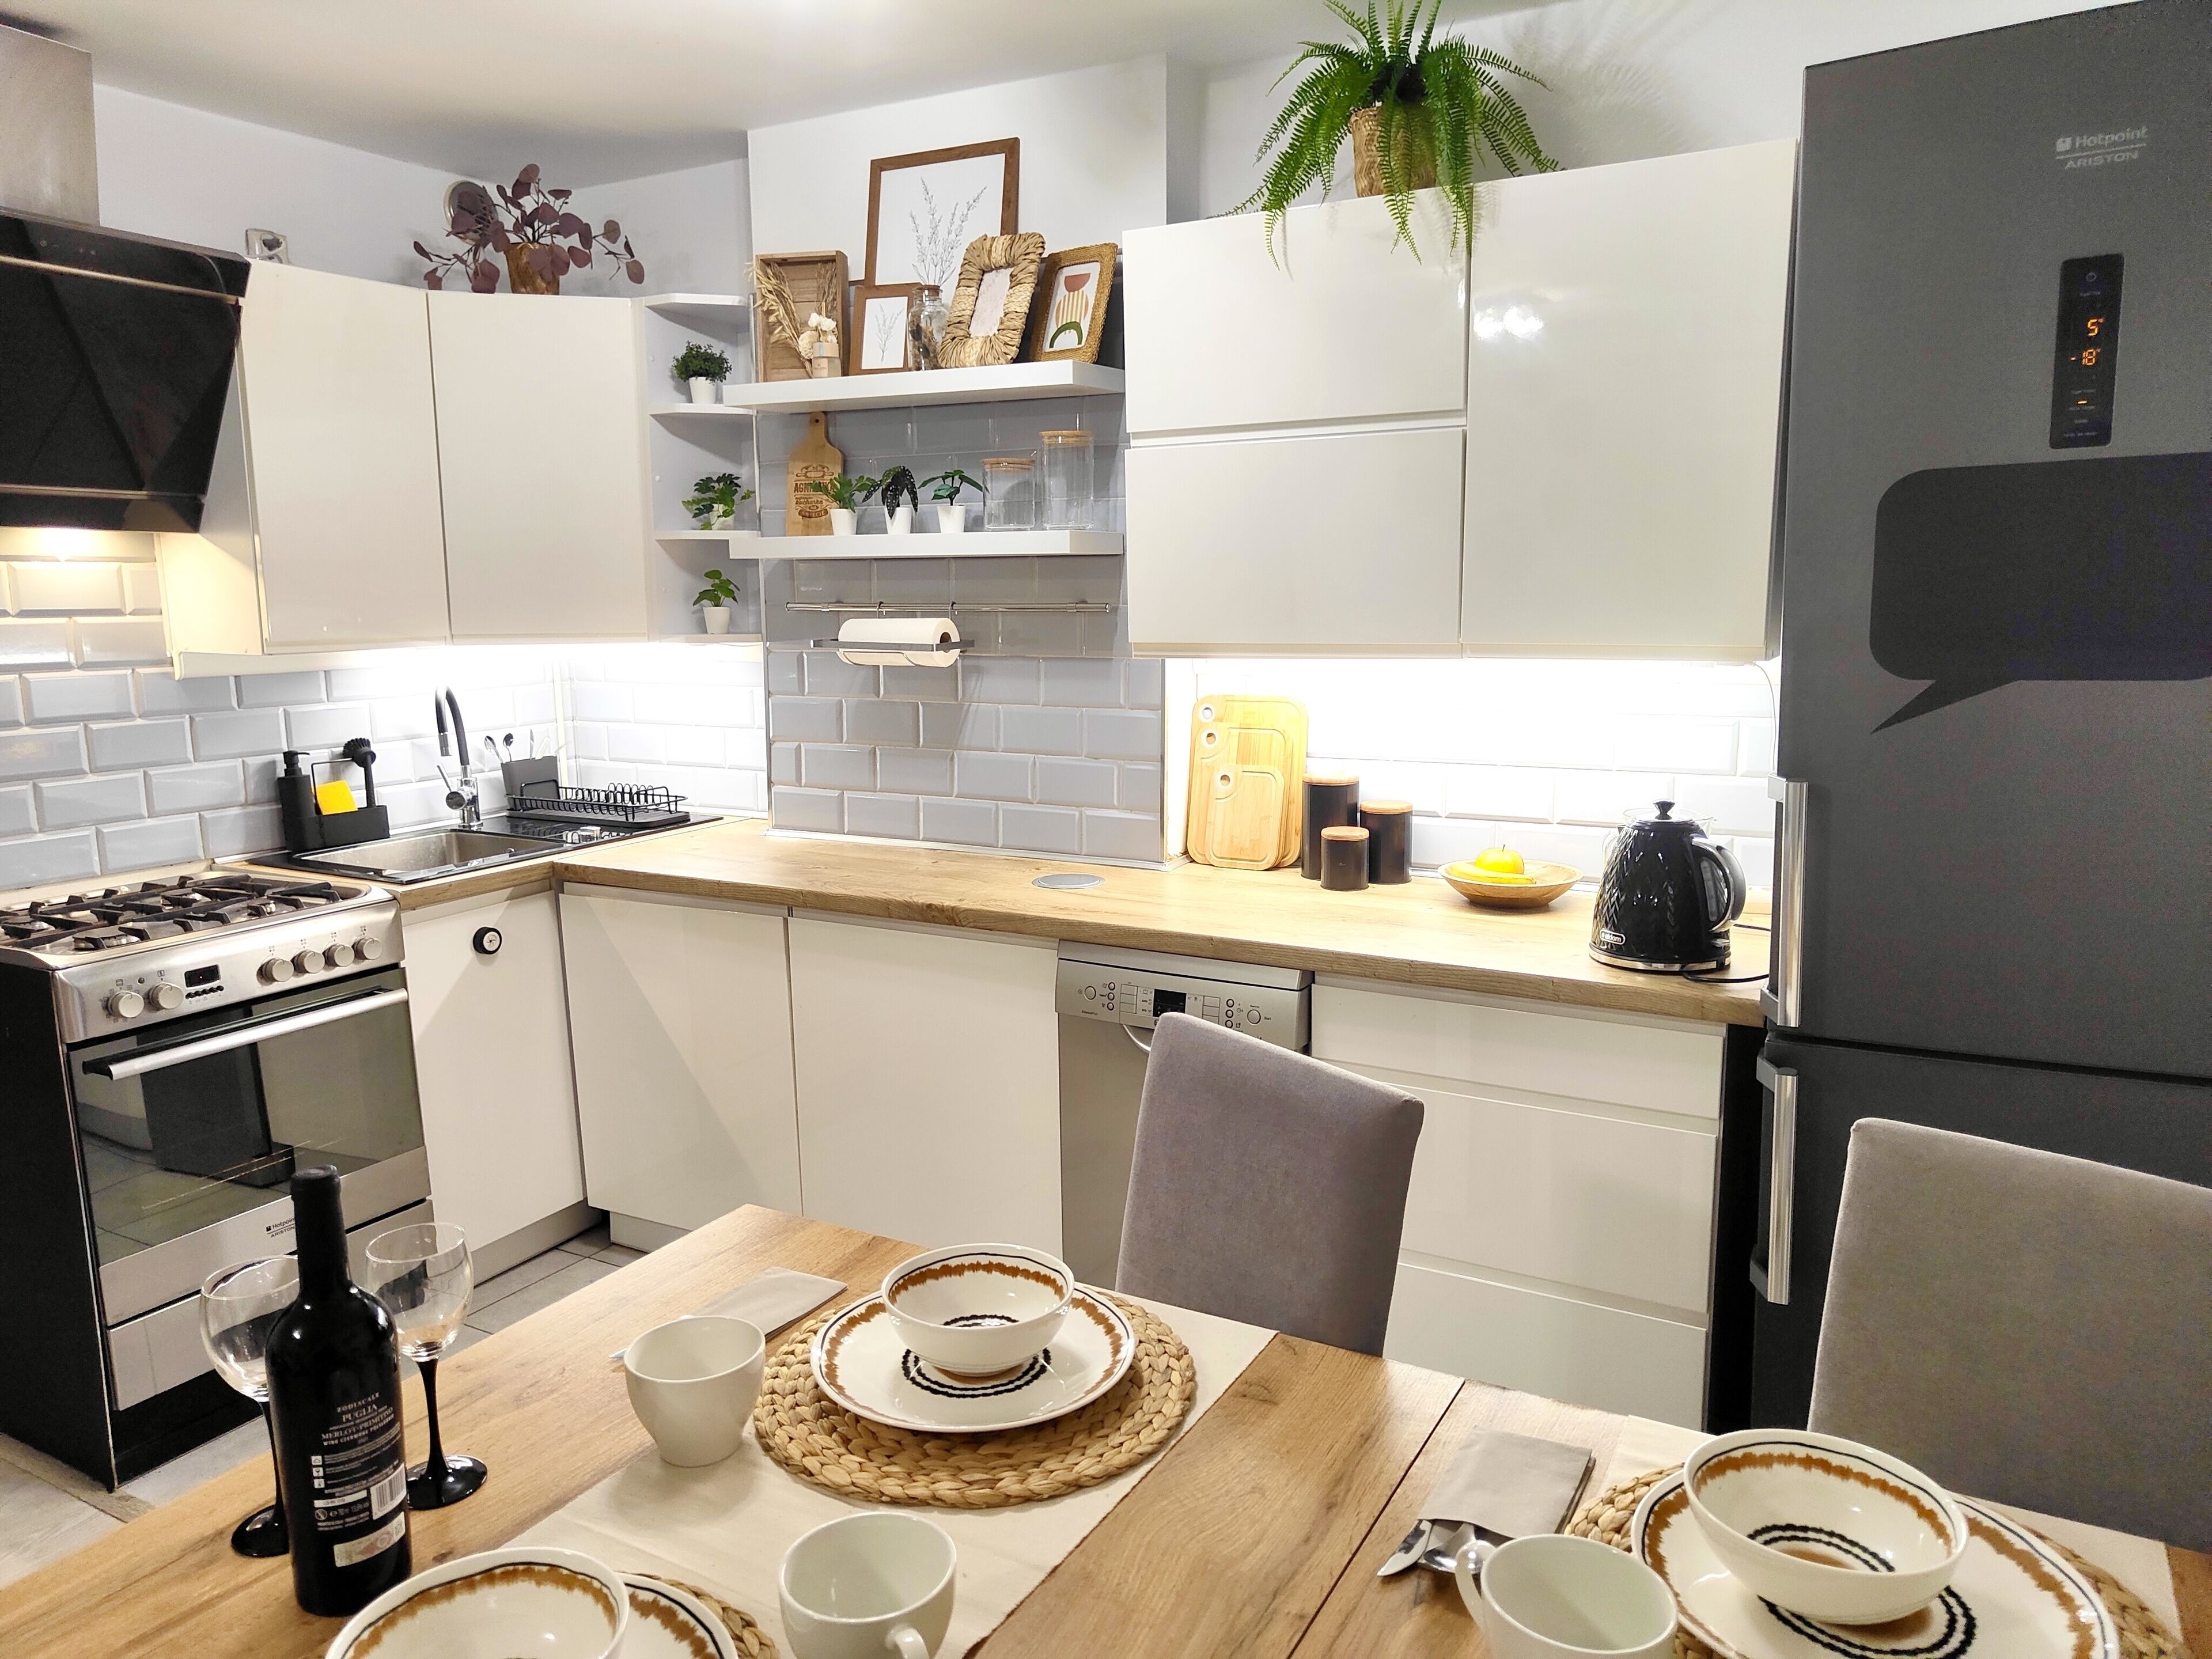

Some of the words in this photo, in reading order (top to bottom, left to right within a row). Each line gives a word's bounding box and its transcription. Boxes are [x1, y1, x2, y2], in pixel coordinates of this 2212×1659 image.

[2075, 126, 2148, 147] Hotpoint
[2065, 150, 2139, 169] ARISTON
[272, 1218, 295, 1229] Hotpoin
[337, 1392, 380, 1413] ZODIACALE
[342, 1403, 378, 1422] PUGLIA
